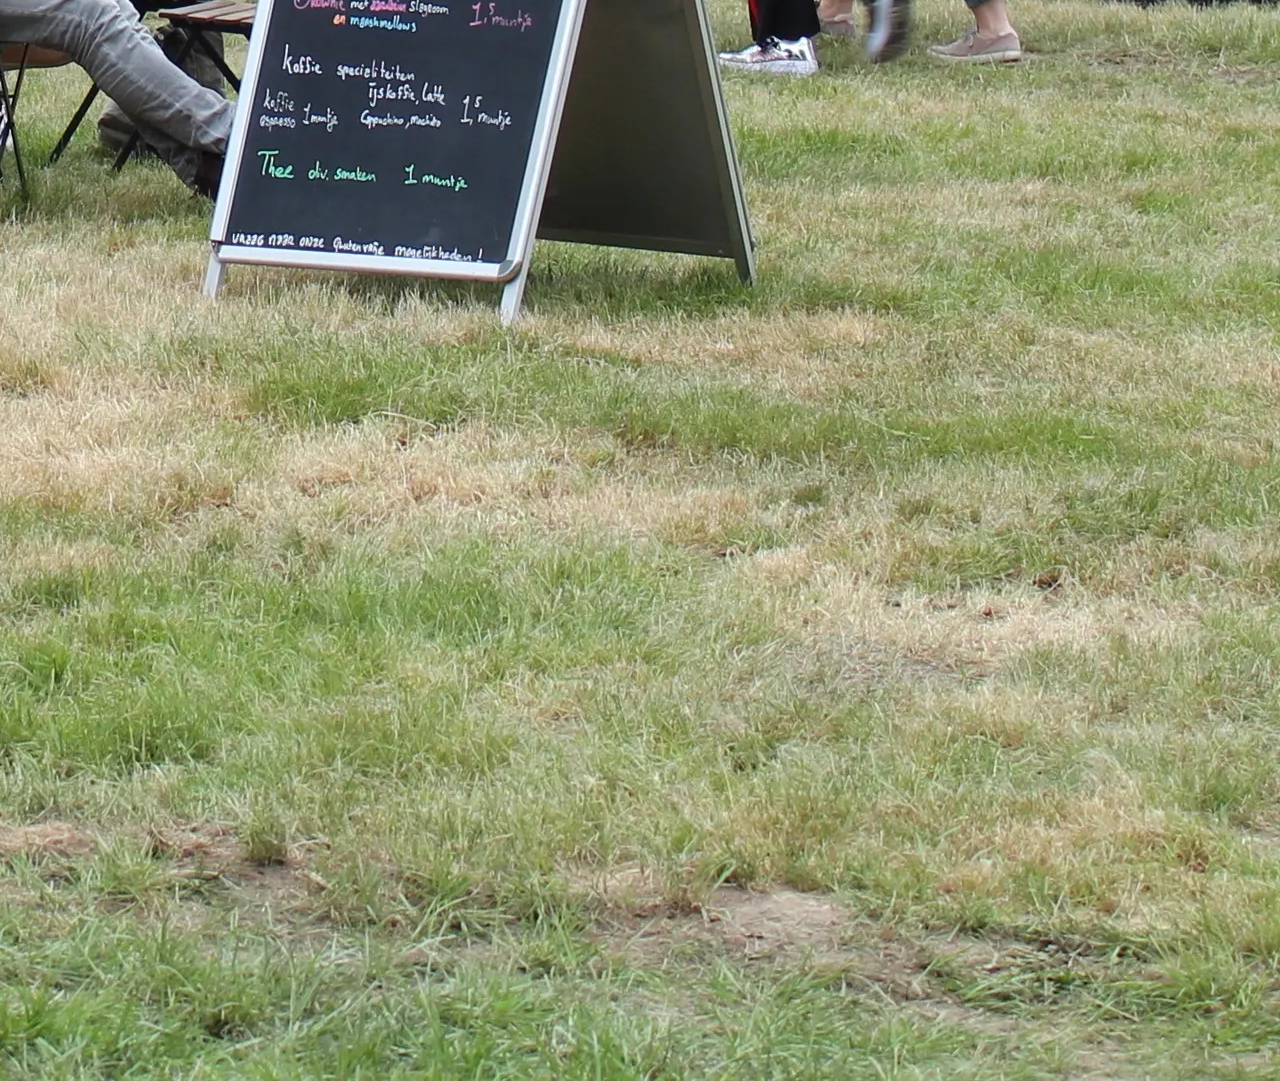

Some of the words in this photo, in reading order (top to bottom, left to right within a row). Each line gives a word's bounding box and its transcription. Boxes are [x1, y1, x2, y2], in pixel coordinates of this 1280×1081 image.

[257, 150, 294, 179] Thee
[334, 166, 376, 183] smaken
[404, 164, 418, 185] 1
[422, 174, 468, 192] muntje
